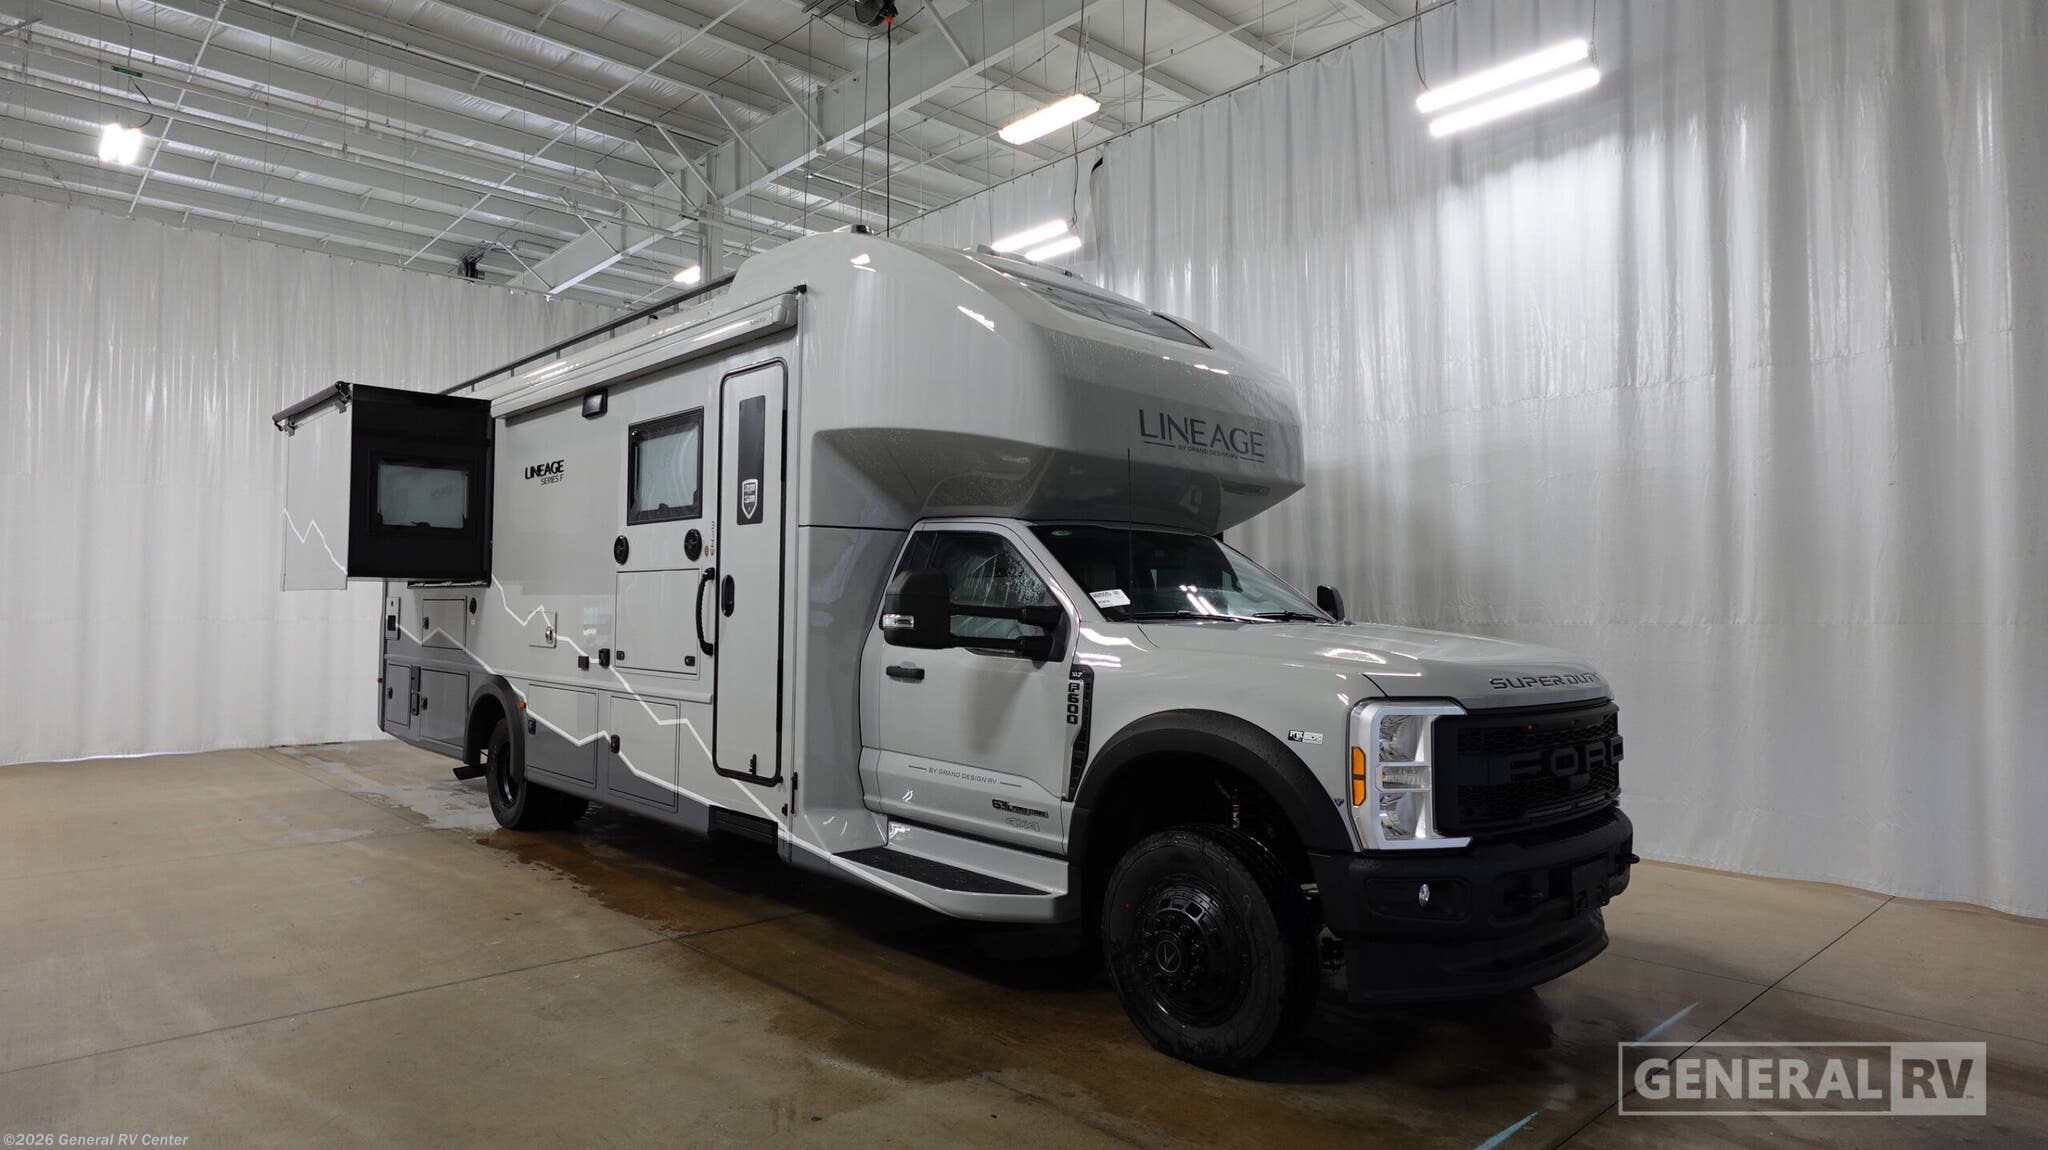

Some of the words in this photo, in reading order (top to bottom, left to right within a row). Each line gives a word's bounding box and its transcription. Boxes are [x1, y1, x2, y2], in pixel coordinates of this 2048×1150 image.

[1139, 408, 1265, 457] LINEAGE
[525, 459, 564, 480] LINEAGE
[540, 474, 559, 485] SERIES
[1489, 675, 1565, 690] SUPER
[1066, 682, 1080, 725] F600
[1505, 735, 1624, 786] FORD
[939, 768, 961, 778] GRAND
[961, 772, 987, 783] DESIGN
[987, 777, 998, 785] RV
